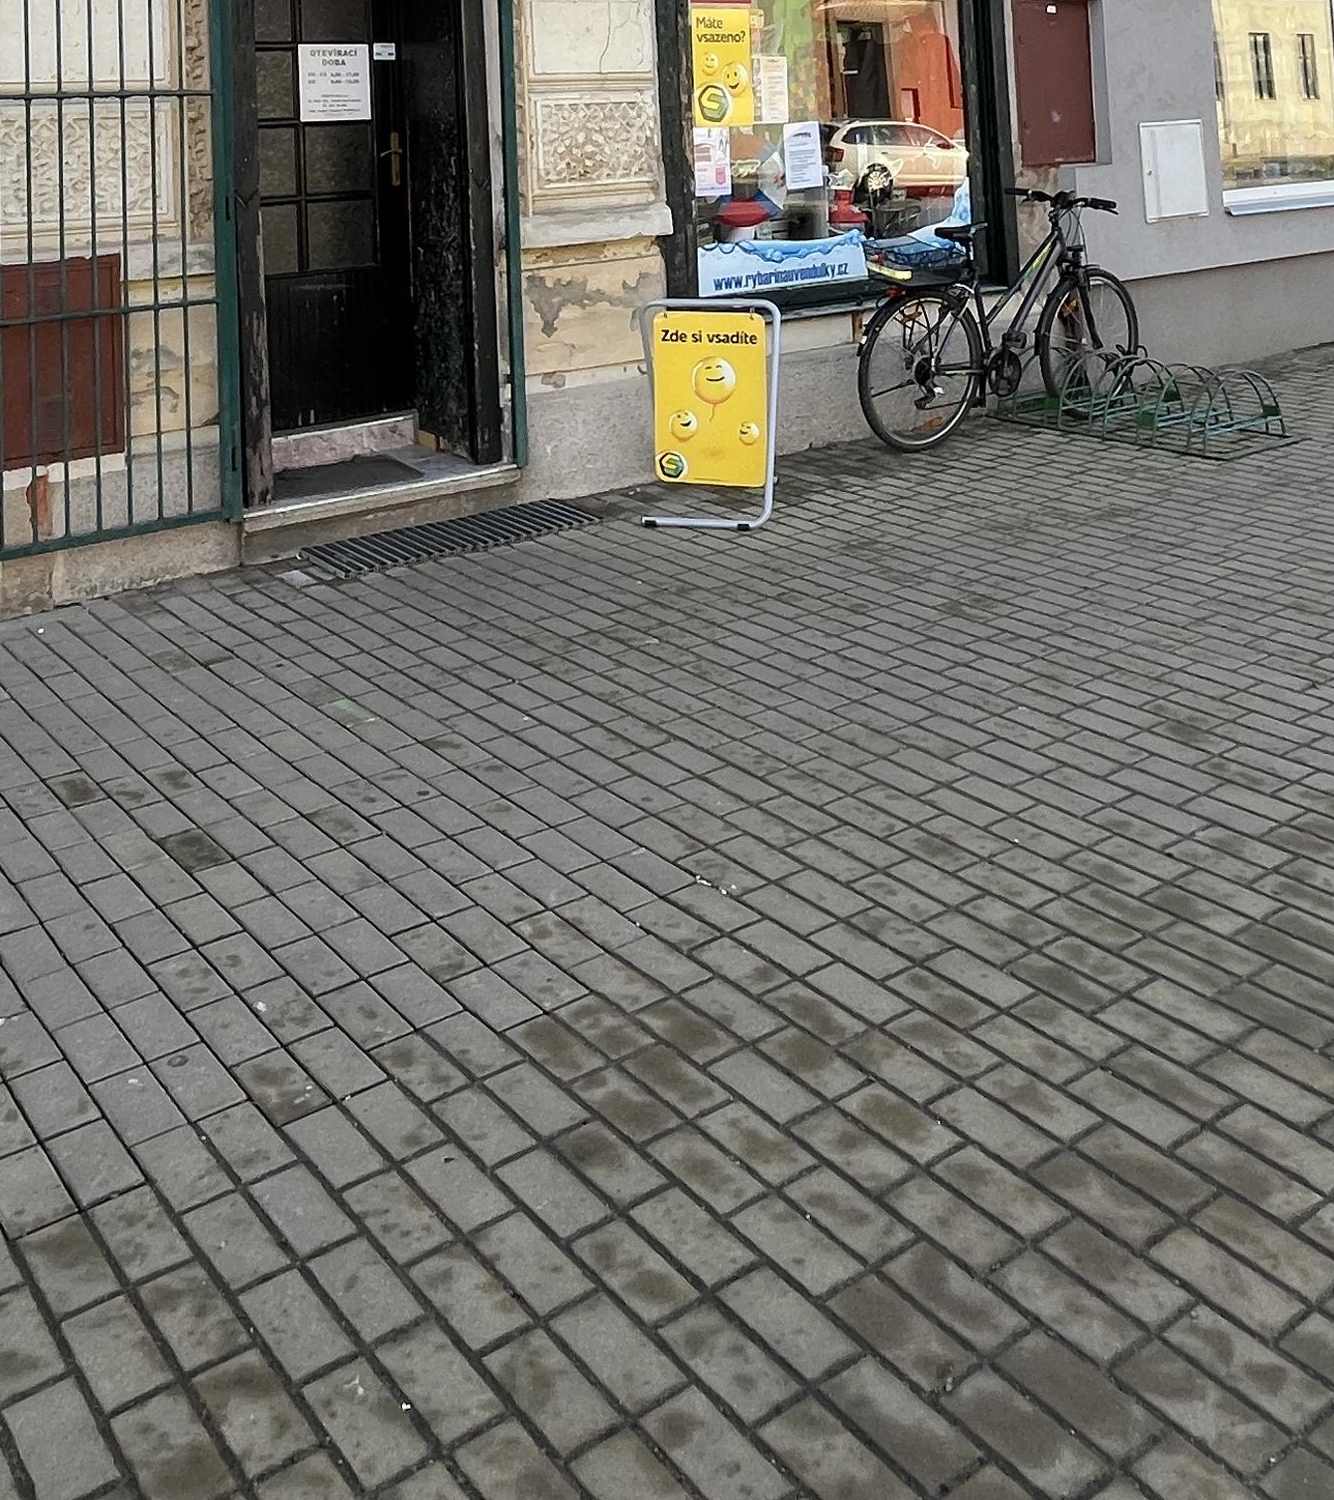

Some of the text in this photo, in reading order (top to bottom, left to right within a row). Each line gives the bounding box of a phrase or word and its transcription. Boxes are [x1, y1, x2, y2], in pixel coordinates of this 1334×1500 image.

[696, 16, 724, 29] Máte
[696, 30, 746, 43] vsazeno?
[321, 59, 347, 67] DOBA
[660, 329, 758, 345] Zde si vsadíte
